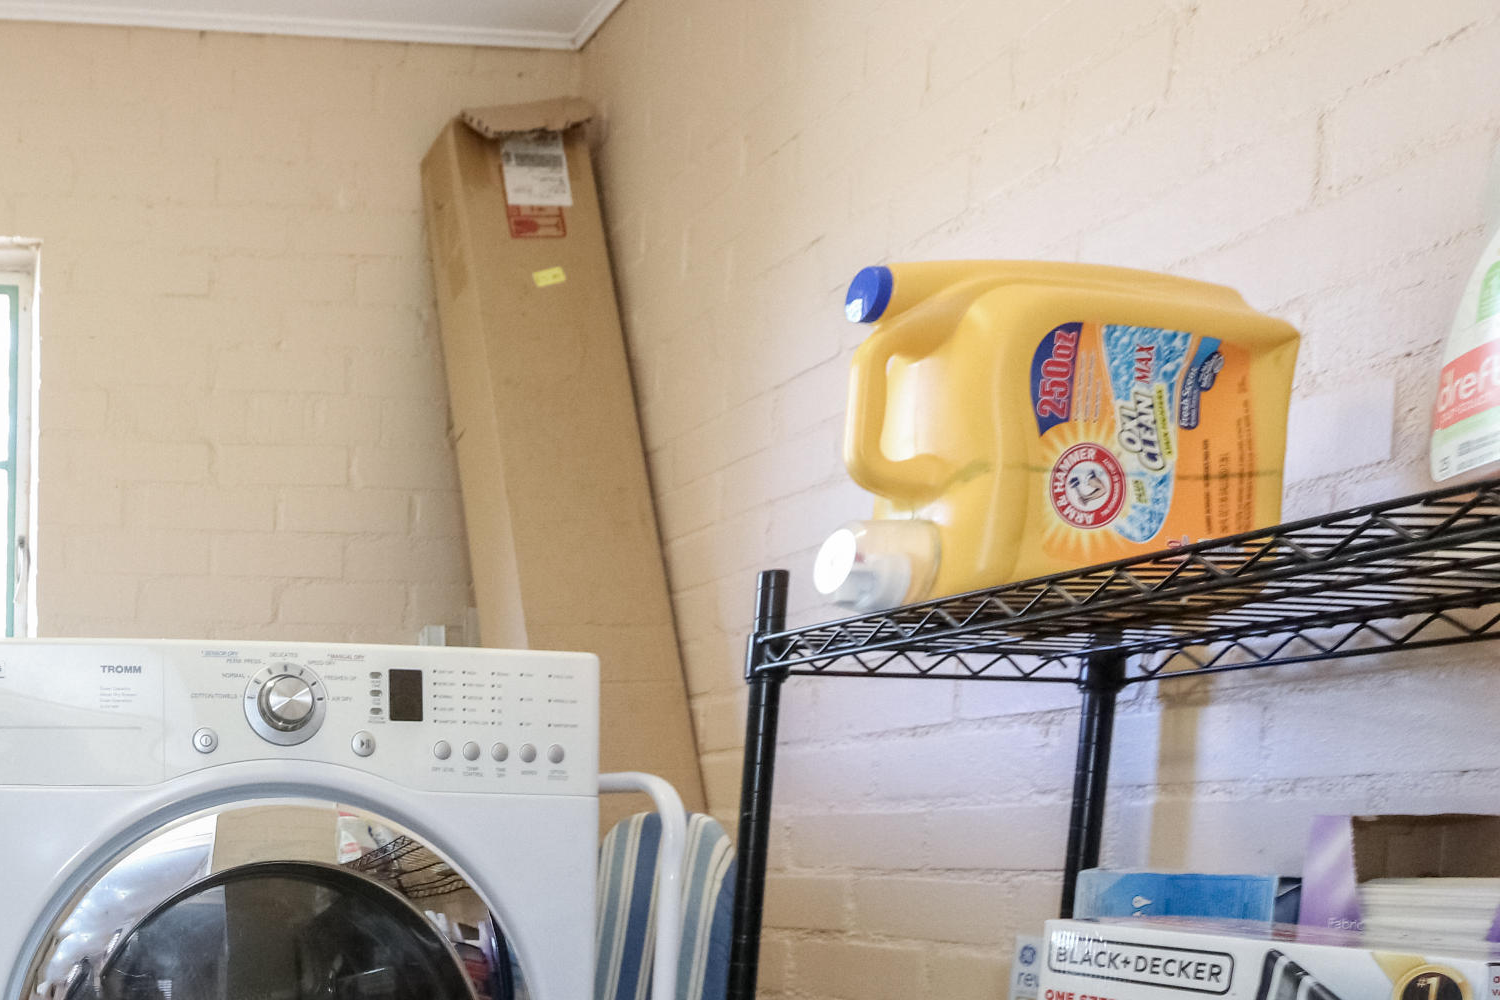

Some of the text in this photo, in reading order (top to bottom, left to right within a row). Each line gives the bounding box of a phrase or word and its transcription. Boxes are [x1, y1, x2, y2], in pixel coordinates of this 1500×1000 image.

[1037, 330, 1078, 419] 250oz
[1135, 344, 1155, 384] MAX
[1182, 367, 1199, 396] Scent
[1118, 405, 1142, 453] OXI
[1179, 400, 1189, 427] Fresh
[1133, 392, 1165, 471] CLEAN
[1053, 448, 1098, 493] HAMMER
[1056, 494, 1068, 506] &
[1062, 504, 1095, 525] ARM
[100, 665, 142, 674] TROMM
[1327, 916, 1365, 932] Fabric
[1056, 946, 1223, 983] BLACK+DECKER
